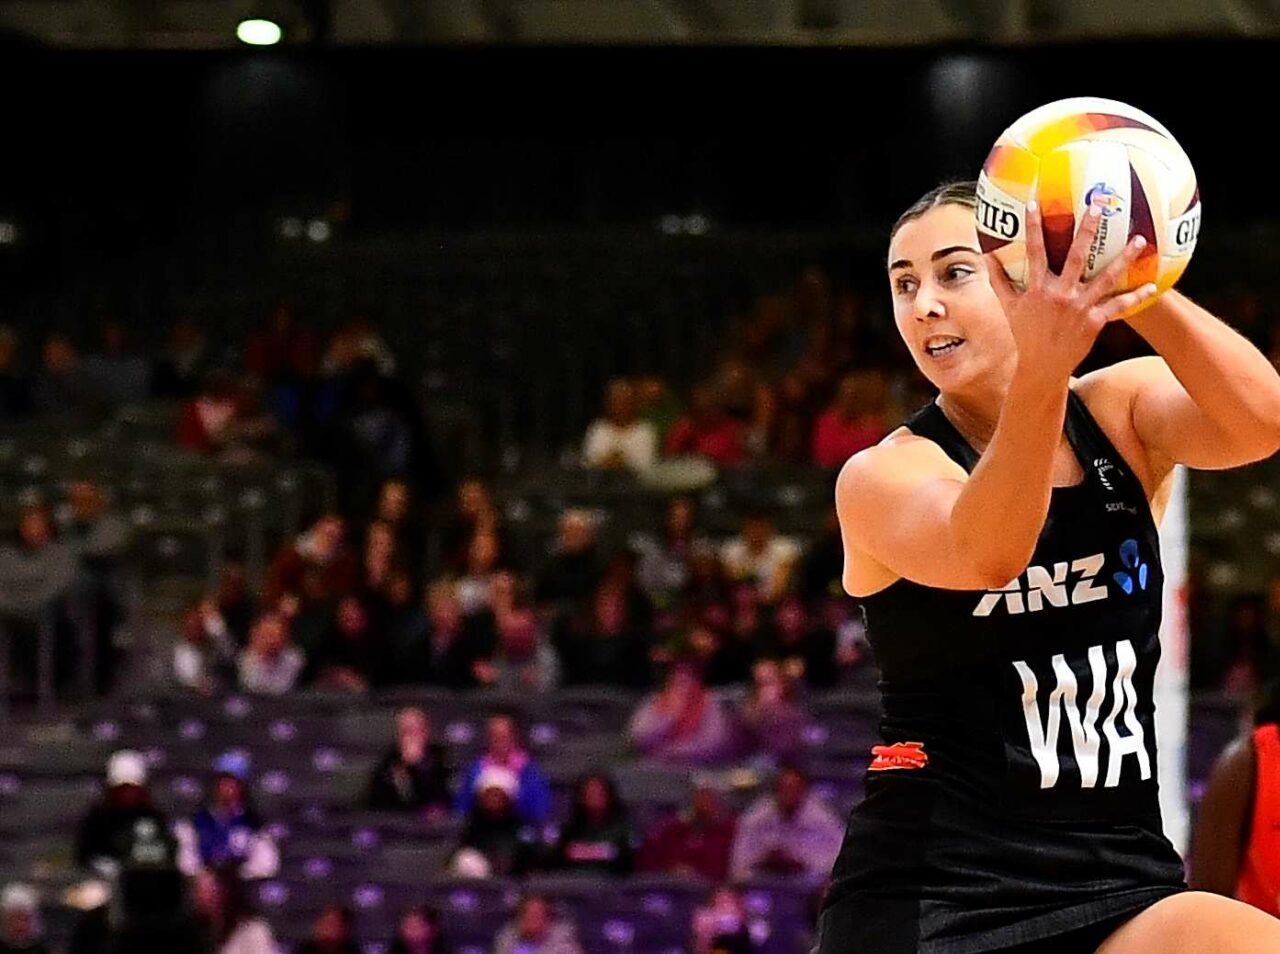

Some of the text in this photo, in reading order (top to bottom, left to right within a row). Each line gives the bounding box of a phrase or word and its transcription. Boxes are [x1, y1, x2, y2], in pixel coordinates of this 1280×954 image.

[1087, 253, 1096, 271] CUP
[1097, 218, 1109, 256] NETBALL
[972, 553, 1109, 617] ANZ
[1012, 639, 1151, 789] WA
